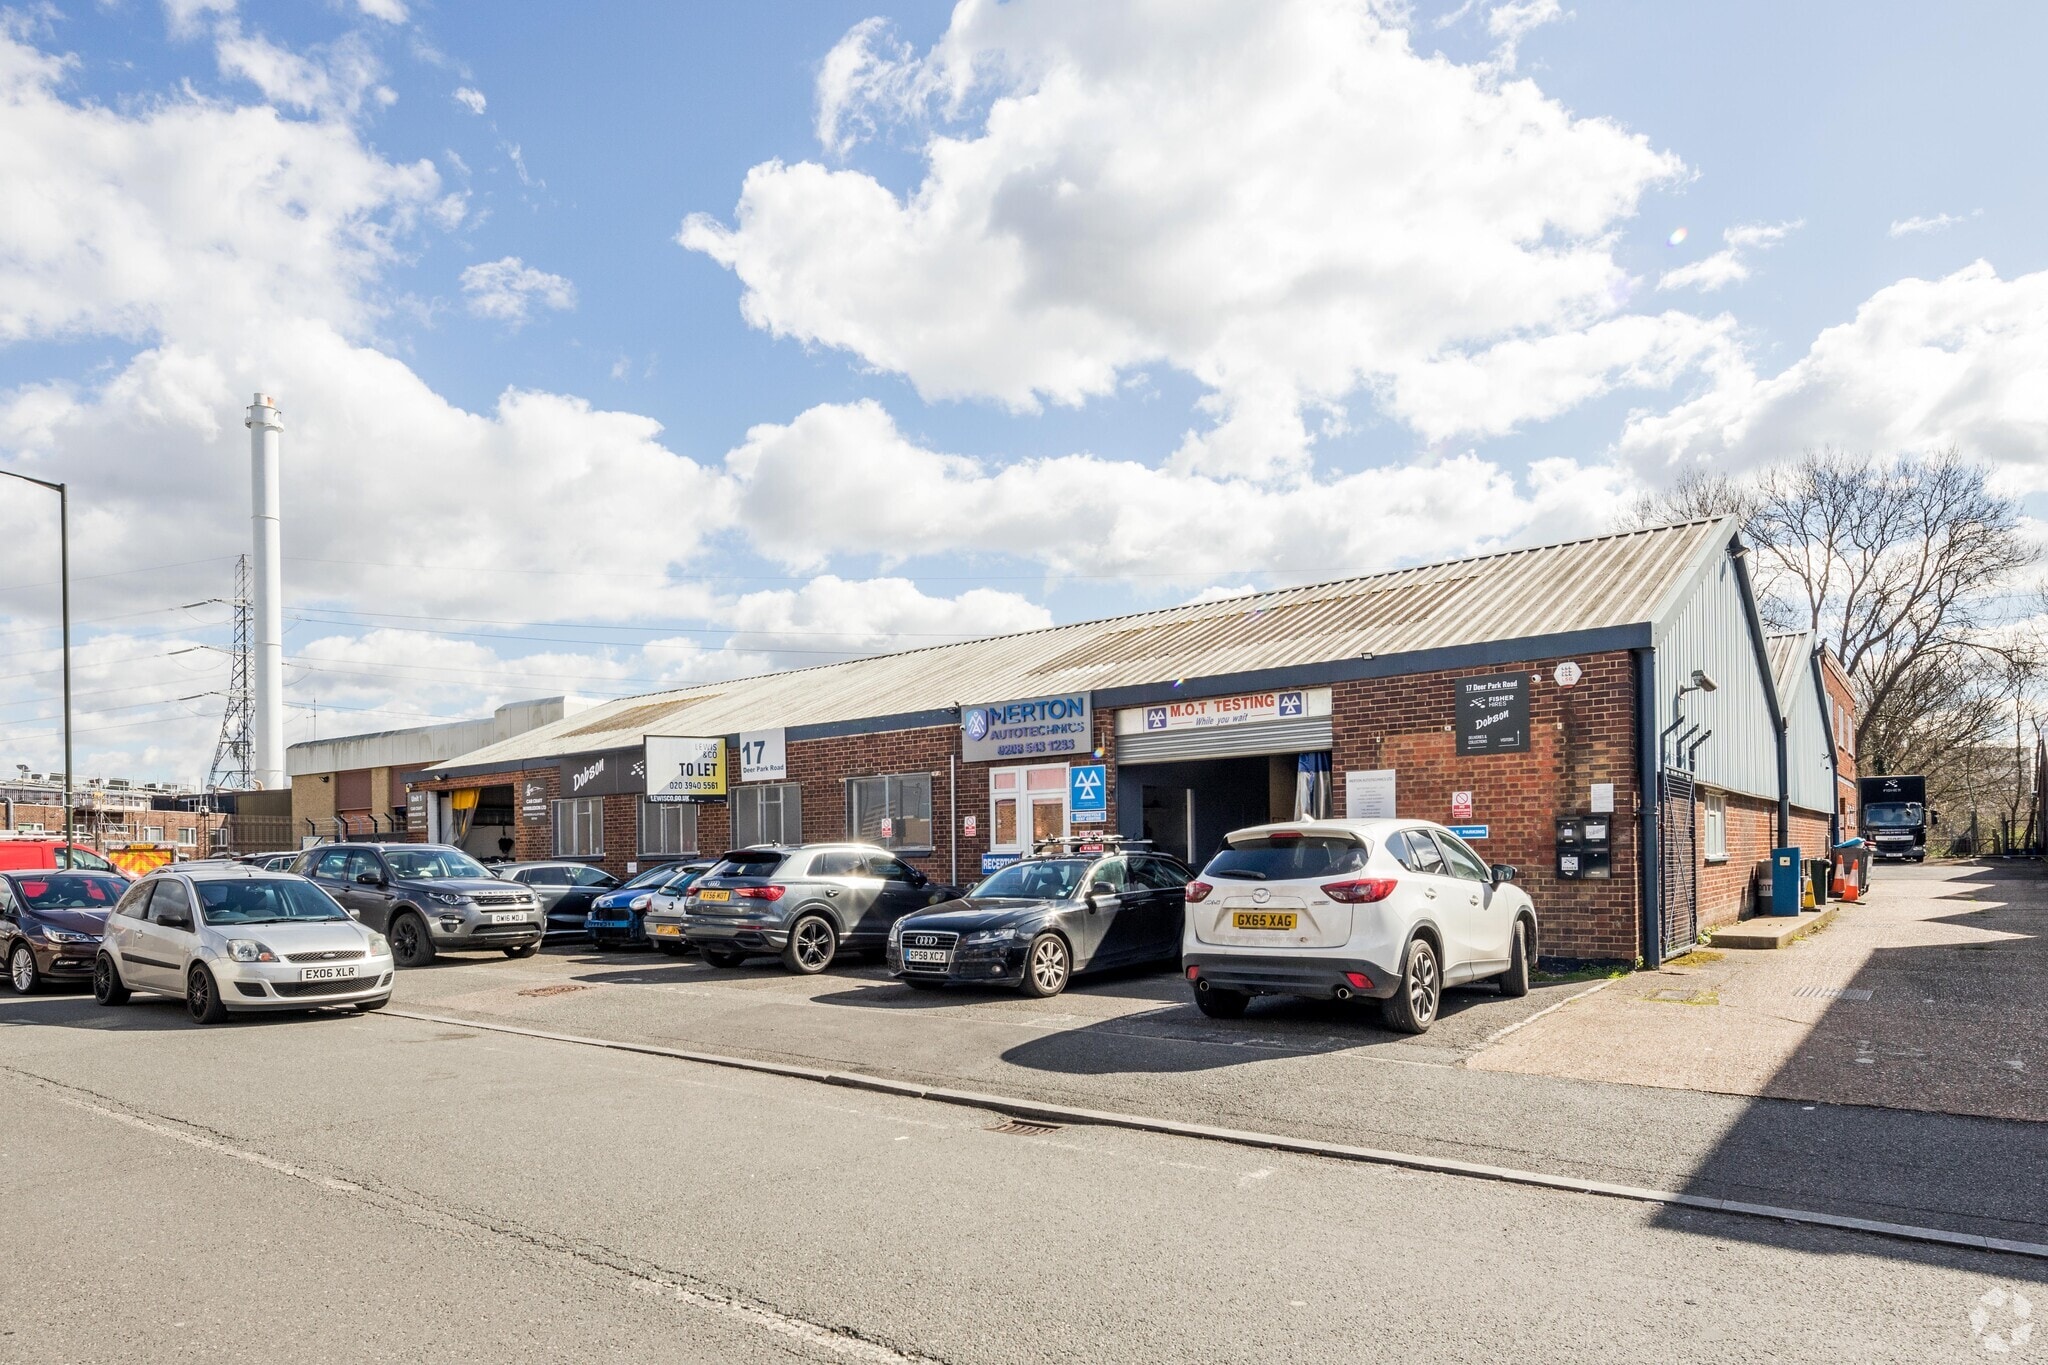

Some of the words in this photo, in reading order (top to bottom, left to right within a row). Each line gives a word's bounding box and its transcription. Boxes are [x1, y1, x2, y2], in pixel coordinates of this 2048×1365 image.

[1473, 683, 1486, 691] Deer
[1487, 681, 1501, 689] Park
[1502, 680, 1517, 688] Road
[989, 698, 1083, 726] MERTON
[1170, 702, 1207, 717] M.O.T
[1214, 694, 1275, 712] TESTING
[1196, 716, 1214, 726] While
[1217, 716, 1229, 725] you
[1232, 713, 1248, 722] wait
[1475, 710, 1509, 730] Dobson
[990, 721, 1084, 740] AUTOTECHNICS
[695, 743, 717, 751] LEWIS
[742, 740, 765, 765] 17
[703, 751, 717, 759] &CO
[573, 758, 604, 791] Dobson
[679, 763, 693, 776] TO
[698, 763, 717, 776] LET
[669, 781, 682, 790] 020
[684, 781, 701, 789] 3940
[703, 781, 718, 789] 5561
[1238, 914, 1266, 926] GX65
[1269, 915, 1291, 926] XAG
[910, 950, 928, 960] SP58
[930, 951, 945, 960] XCZ
[306, 969, 333, 979] EX06
[336, 967, 355, 977] XLR
